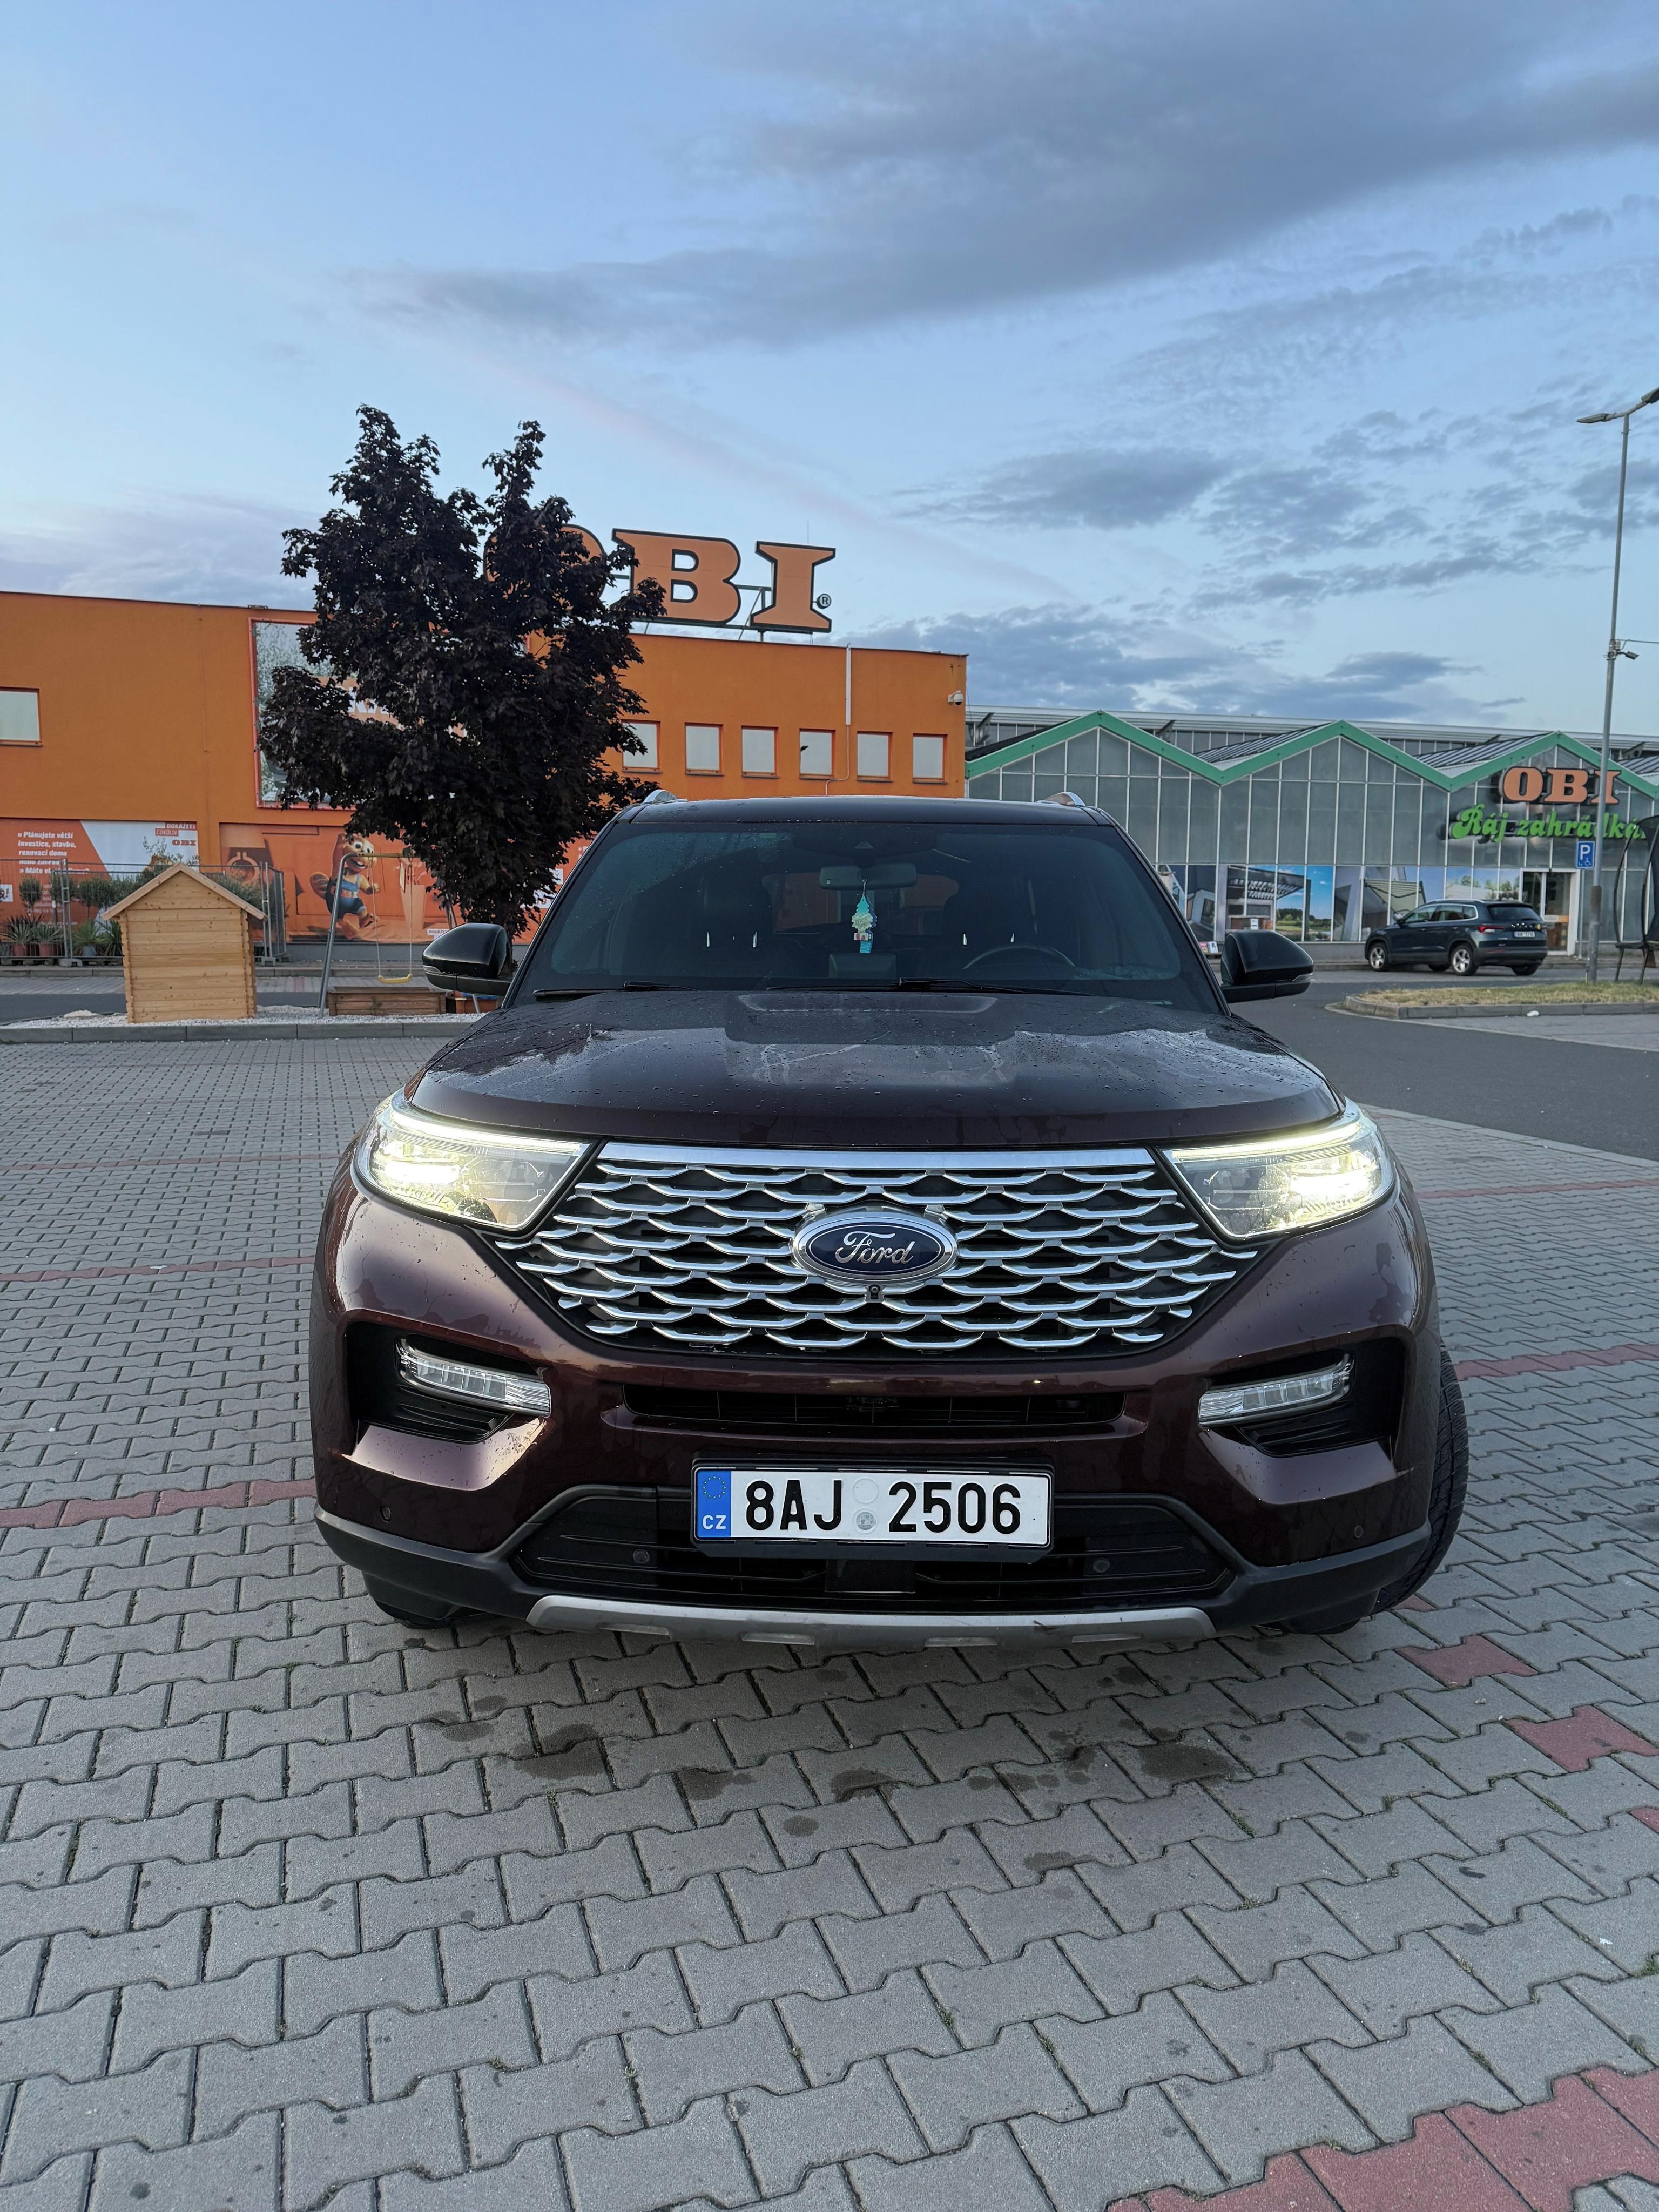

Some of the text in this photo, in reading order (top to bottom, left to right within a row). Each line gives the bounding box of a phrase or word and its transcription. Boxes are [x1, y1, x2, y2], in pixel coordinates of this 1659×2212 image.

[1502, 766, 1620, 804] OBI
[1451, 804, 1509, 843] Ráj
[1580, 844, 1591, 860] P
[835, 1231, 915, 1264] Ford
[702, 1479, 1021, 1534] CZ 8AJ 2506
